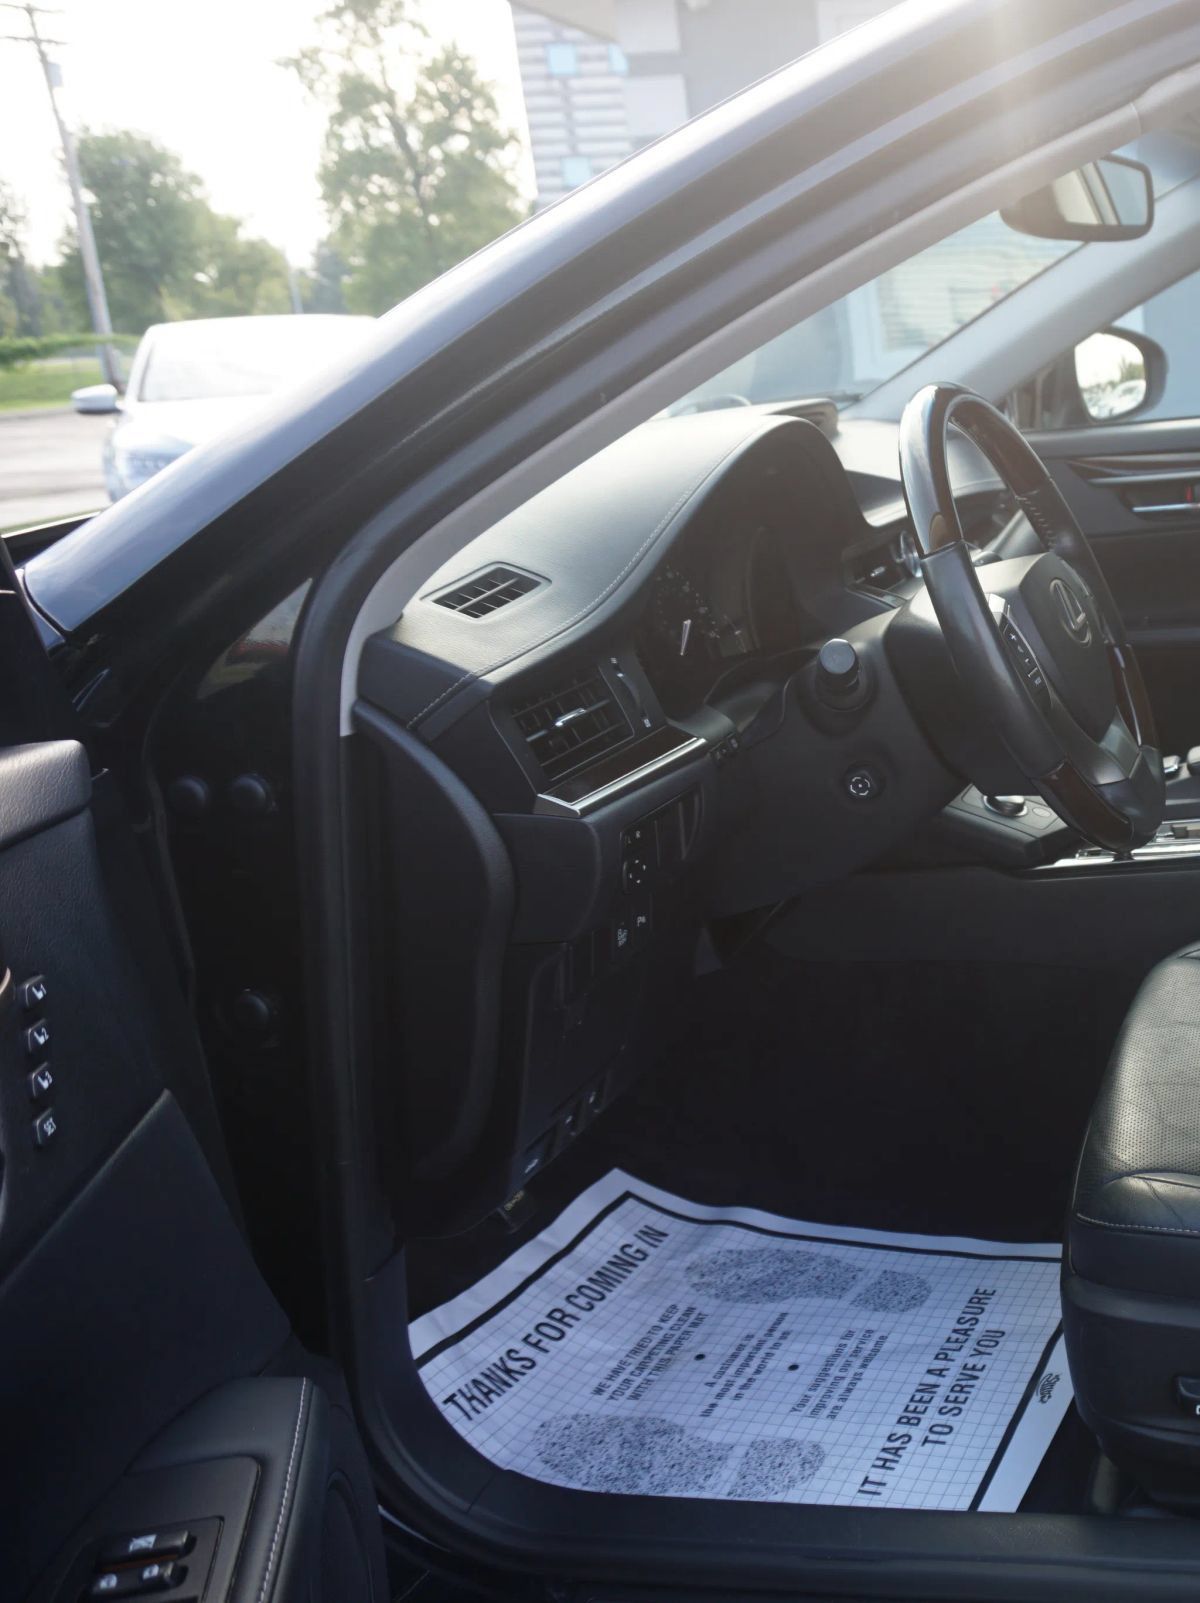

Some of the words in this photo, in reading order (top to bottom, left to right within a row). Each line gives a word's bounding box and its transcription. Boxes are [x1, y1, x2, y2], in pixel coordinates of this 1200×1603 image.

[442, 1348, 537, 1421] THANKS
[522, 1308, 581, 1353] FOR
[565, 1243, 649, 1312] COMING
[634, 1225, 669, 1248] IN
[934, 1287, 997, 1363] PLEASURE
[591, 1382, 610, 1396] WE
[605, 1359, 632, 1382] HAVE
[625, 1332, 653, 1361] TRIED
[648, 1324, 663, 1336] TO
[658, 1304, 680, 1324] KEEP
[607, 1377, 634, 1401] YOUR
[630, 1332, 676, 1378] CARPETING
[669, 1306, 697, 1332] CLEAN
[626, 1377, 655, 1401] WITH
[648, 1356, 673, 1376] THIS
[665, 1330, 695, 1356] PAPER
[688, 1312, 709, 1329] MAT
[700, 1402, 719, 1418] the
[714, 1379, 737, 1400] most
[734, 1339, 768, 1378] important
[764, 1312, 790, 1338] person
[712, 1343, 748, 1381] customer
[752, 1351, 776, 1376] world
[769, 1342, 783, 1351] to
[838, 1359, 854, 1373] our
[849, 1329, 875, 1358] service
[738, 1377, 757, 1391] the
[789, 1394, 809, 1414] Your
[808, 1343, 849, 1392] suggestions
[842, 1330, 857, 1344] for
[826, 1405, 843, 1420] are
[837, 1371, 864, 1403] always
[858, 1335, 889, 1369] welcome
[922, 1423, 954, 1448] TO
[938, 1362, 986, 1418] SERVE
[970, 1329, 1007, 1358] YOU
[926, 1367, 949, 1379] A
[733, 1392, 745, 1401] in
[896, 1383, 941, 1427] BEEN
[871, 1432, 912, 1472] HAS
[857, 1476, 887, 1496] IT
